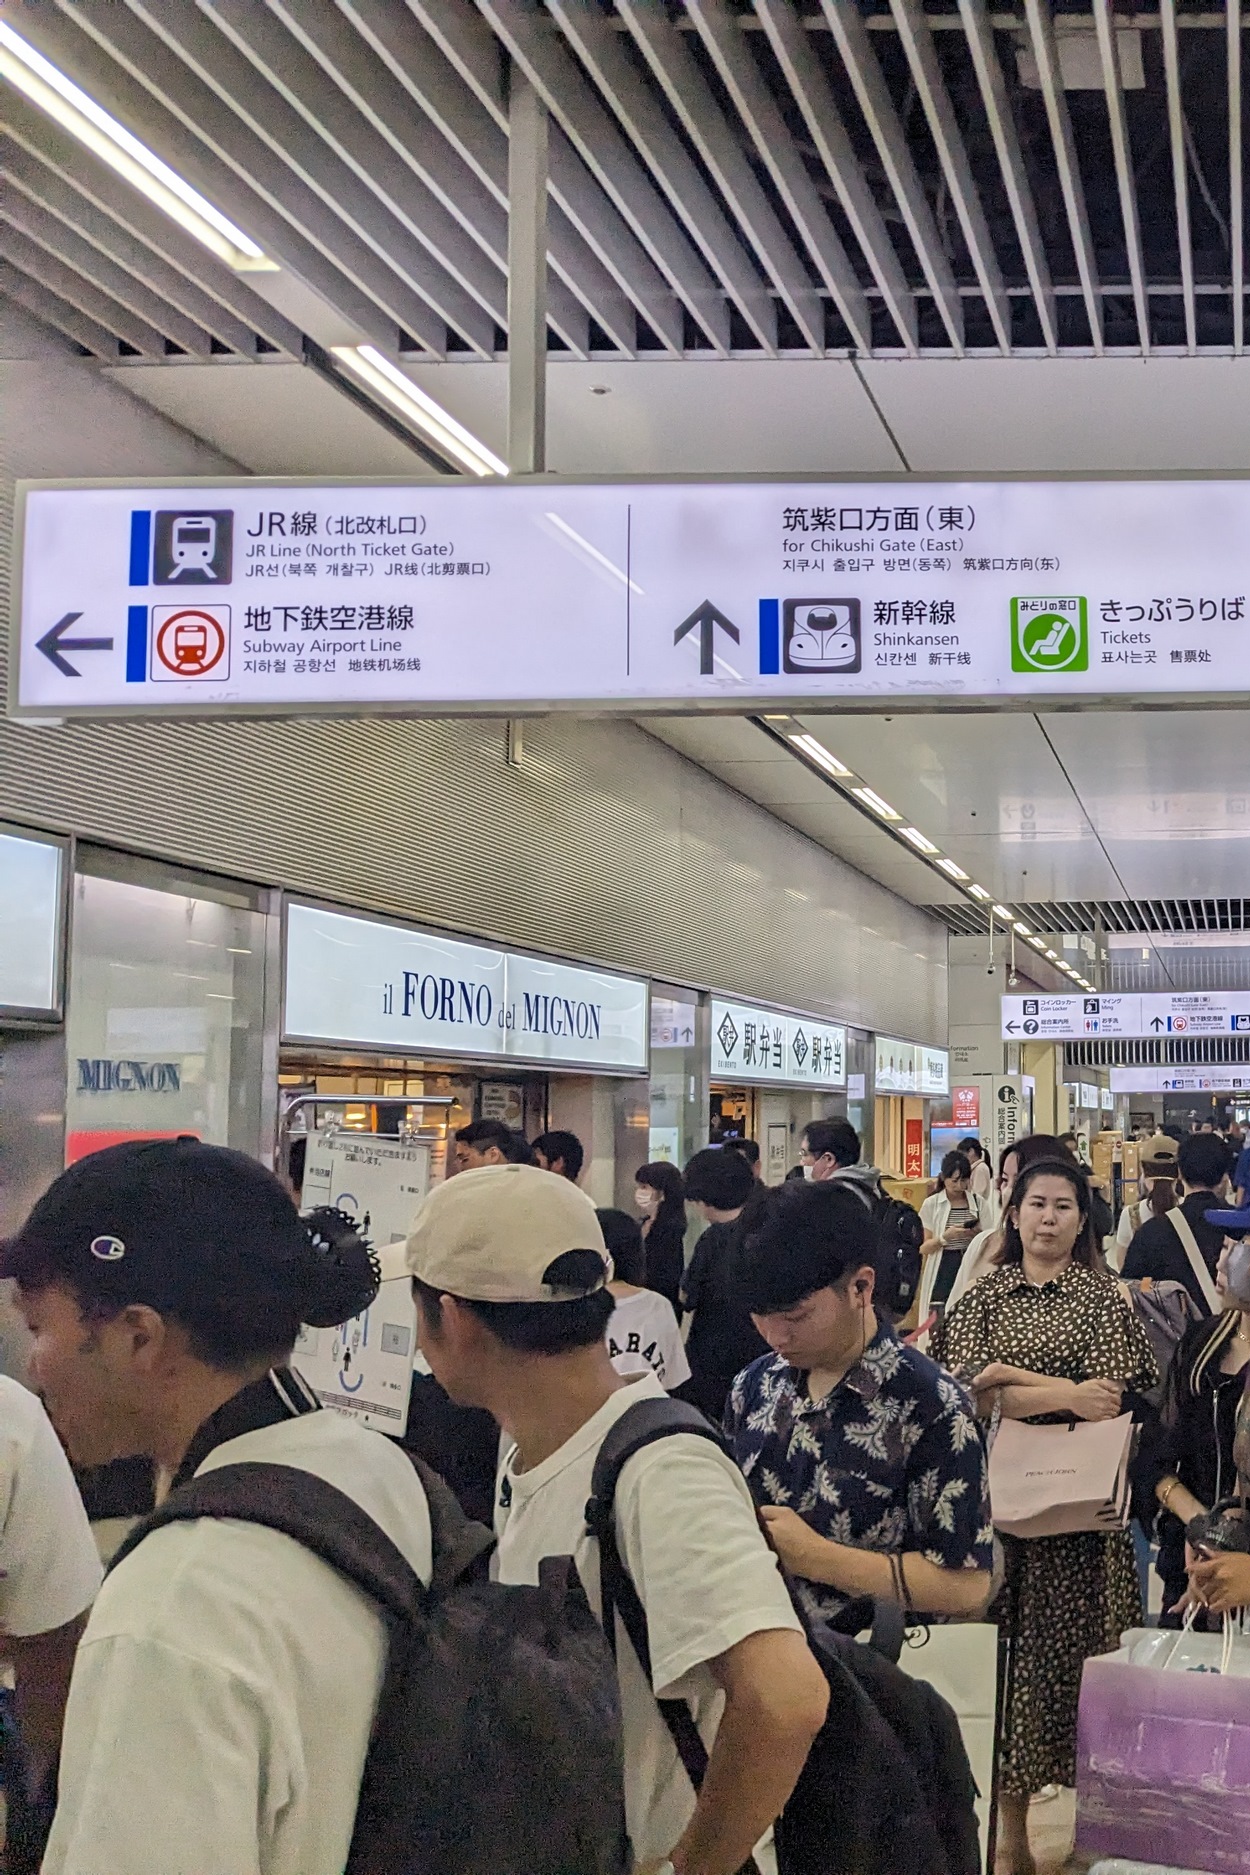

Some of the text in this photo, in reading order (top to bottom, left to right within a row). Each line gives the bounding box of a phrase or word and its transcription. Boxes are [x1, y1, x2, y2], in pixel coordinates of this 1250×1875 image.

[782, 505, 976, 532] 筑紫口方面（東）
[245, 541, 455, 558] JR Line (North Ticket Gate)
[782, 537, 964, 553] for Chikushi Gate (East)
[245, 562, 375, 578] JR선(북쪽 개찰구)
[384, 561, 492, 577] JR线(北剪票口)
[782, 557, 952, 572] 지쿠시 출입구 방면(동쪽)
[963, 556, 1061, 572] 筑紫口方向(东)
[873, 599, 956, 626] 新幹線
[1020, 600, 1077, 611] みどりの窓口
[1099, 597, 1246, 622] きっぷうりば
[243, 604, 415, 633] 地下鉄空港線
[873, 631, 960, 646] Shinkansen
[1100, 630, 1152, 644] Tickets
[243, 637, 402, 656] Subway Airport Line
[348, 657, 421, 672] 地铁机场线
[874, 652, 917, 666] 신칸센
[928, 651, 972, 666] 新干线
[1101, 650, 1158, 664] 표사는곳
[1169, 649, 1212, 664] 售票处
[243, 658, 336, 673] 지하철 공항선
[382, 970, 602, 1041] il FORNO del MIGNON
[742, 1021, 782, 1069] 駅弁当
[811, 1035, 842, 1076] 駅弁当
[76, 1058, 181, 1093] MIGNON
[1007, 1106, 1017, 1144] Inform
[907, 1143, 921, 1177] 明太
